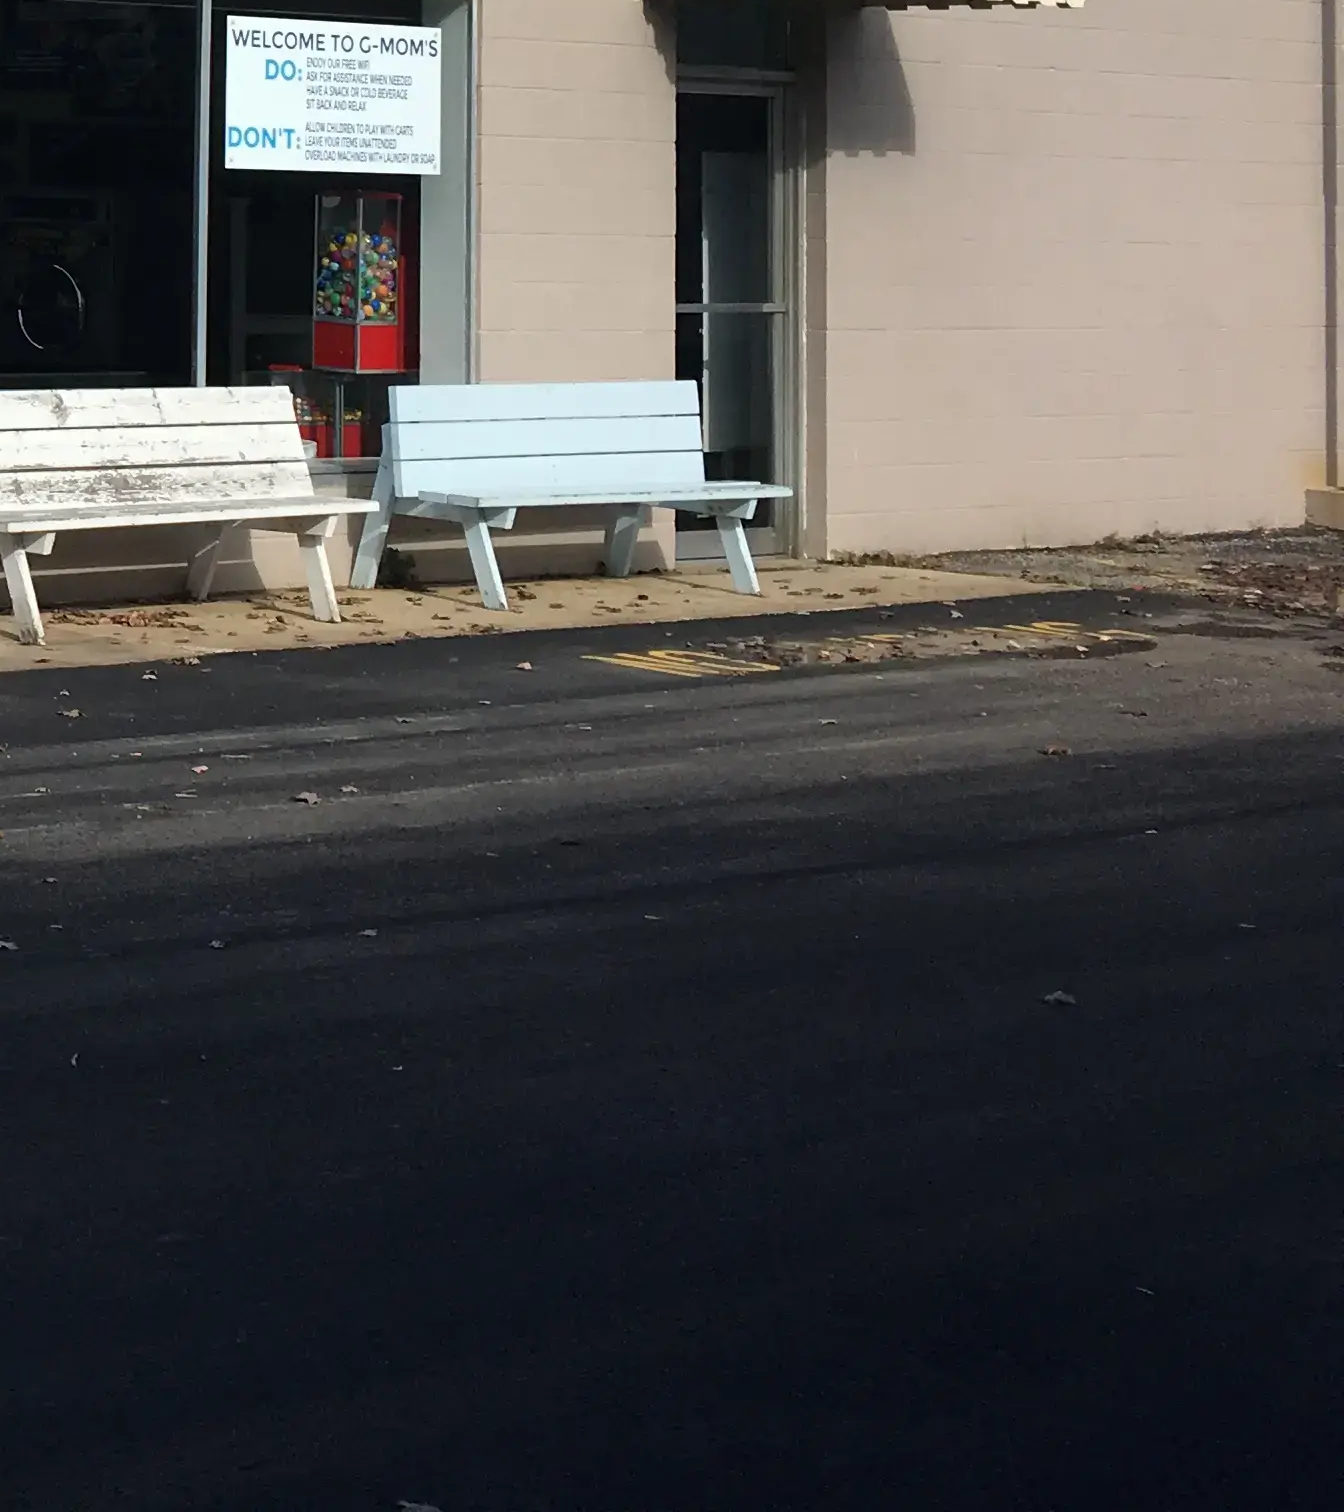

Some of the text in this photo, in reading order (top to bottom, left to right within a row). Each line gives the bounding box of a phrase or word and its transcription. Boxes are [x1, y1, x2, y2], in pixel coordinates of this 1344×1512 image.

[232, 29, 438, 57] WELCOME TO G-MOM'S
[265, 59, 302, 81] DO:
[327, 58, 340, 69] OUR
[341, 58, 356, 70] FREE
[306, 71, 412, 86] ASK FOR ASSISTANCE WHEN NEEDED
[306, 85, 323, 96] HAVE
[329, 86, 349, 97] SNACK
[350, 87, 359, 97] OR
[360, 88, 376, 98] COLD
[377, 88, 408, 100] BEVERAGE
[306, 99, 367, 111] SIT BACK AND RELAX
[305, 122, 414, 136] ALLOW CHILDREN TO PLAY WITH CARTS
[228, 126, 301, 149] DON'T:
[305, 136, 397, 149] LEAVE YOUR ITEMS UNATTENDED
[305, 150, 435, 164] OVERLOAD MACHINES WITH LAUNDRY OR SOAP
